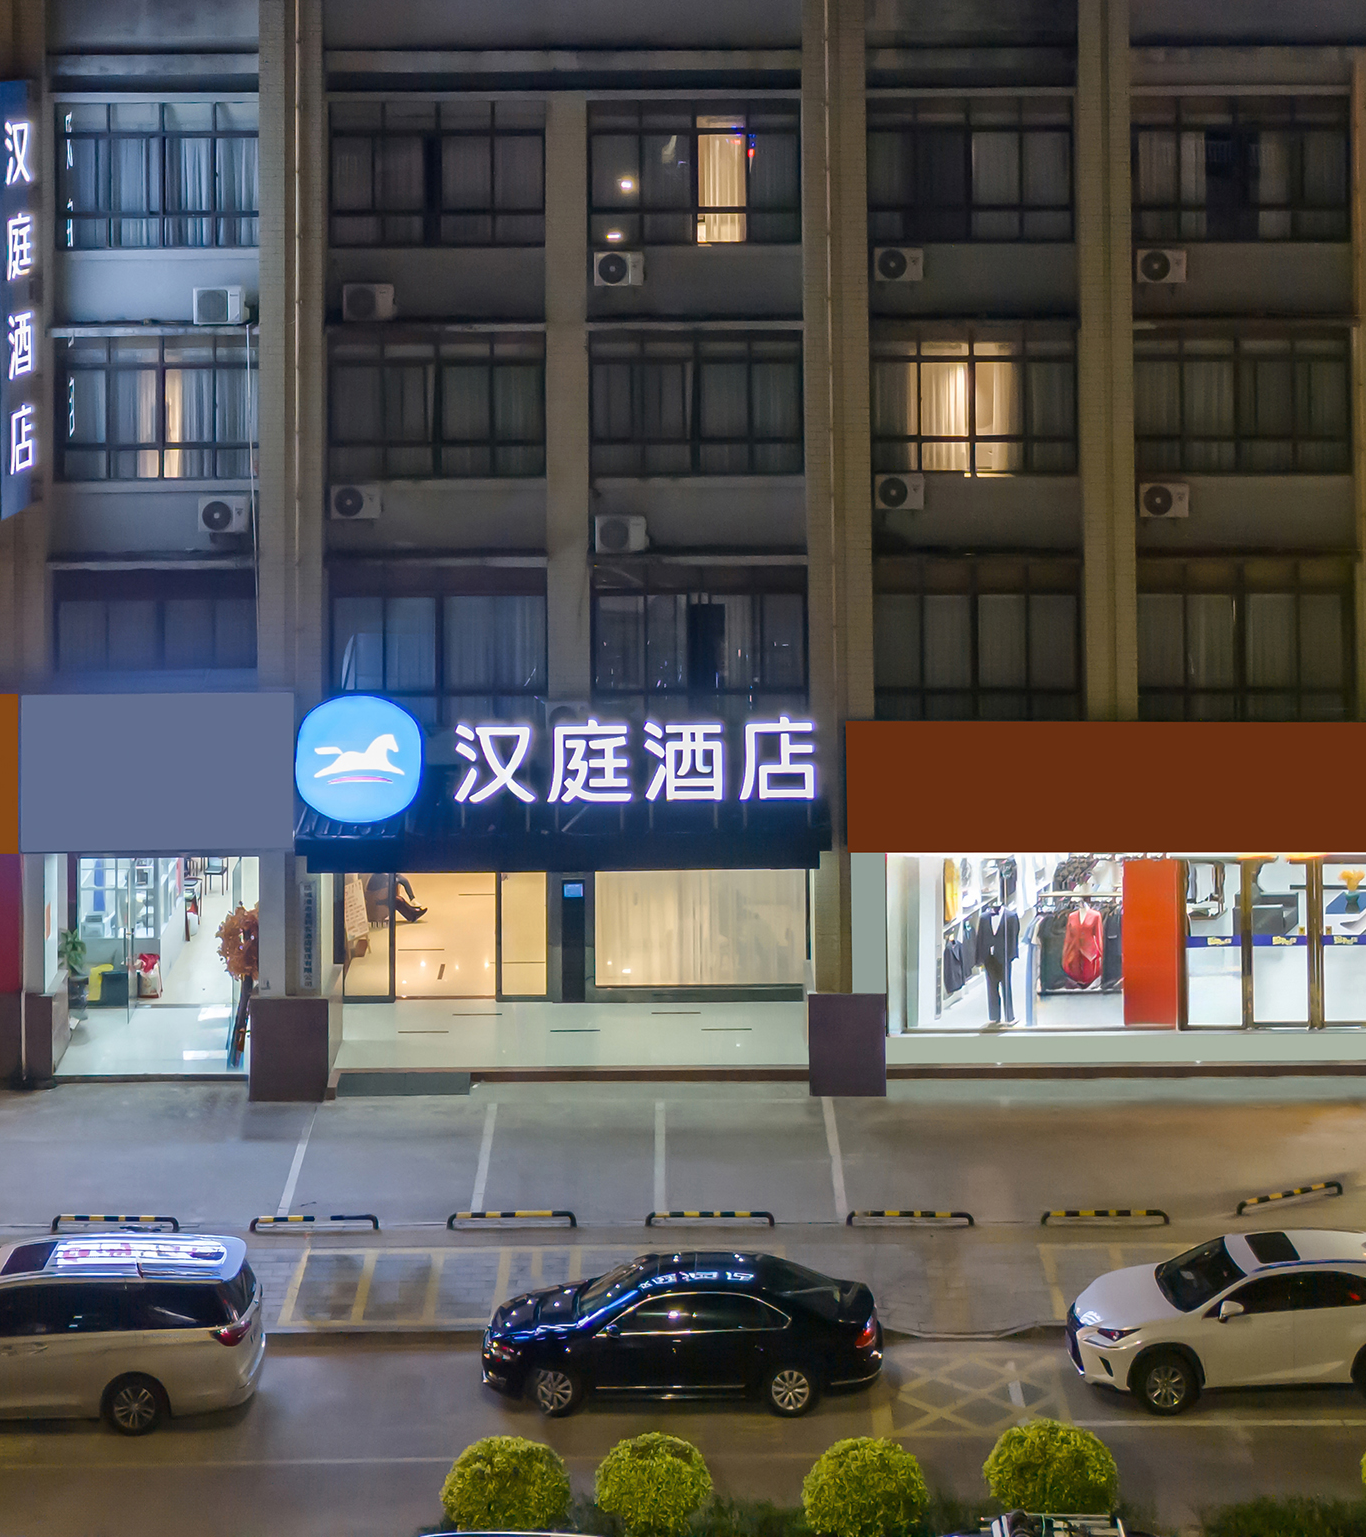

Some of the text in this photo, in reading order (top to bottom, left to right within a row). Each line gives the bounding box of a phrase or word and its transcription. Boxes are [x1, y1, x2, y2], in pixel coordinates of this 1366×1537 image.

[4, 120, 34, 477] 汉庭酒店
[455, 716, 815, 803] 汉庭酒店
